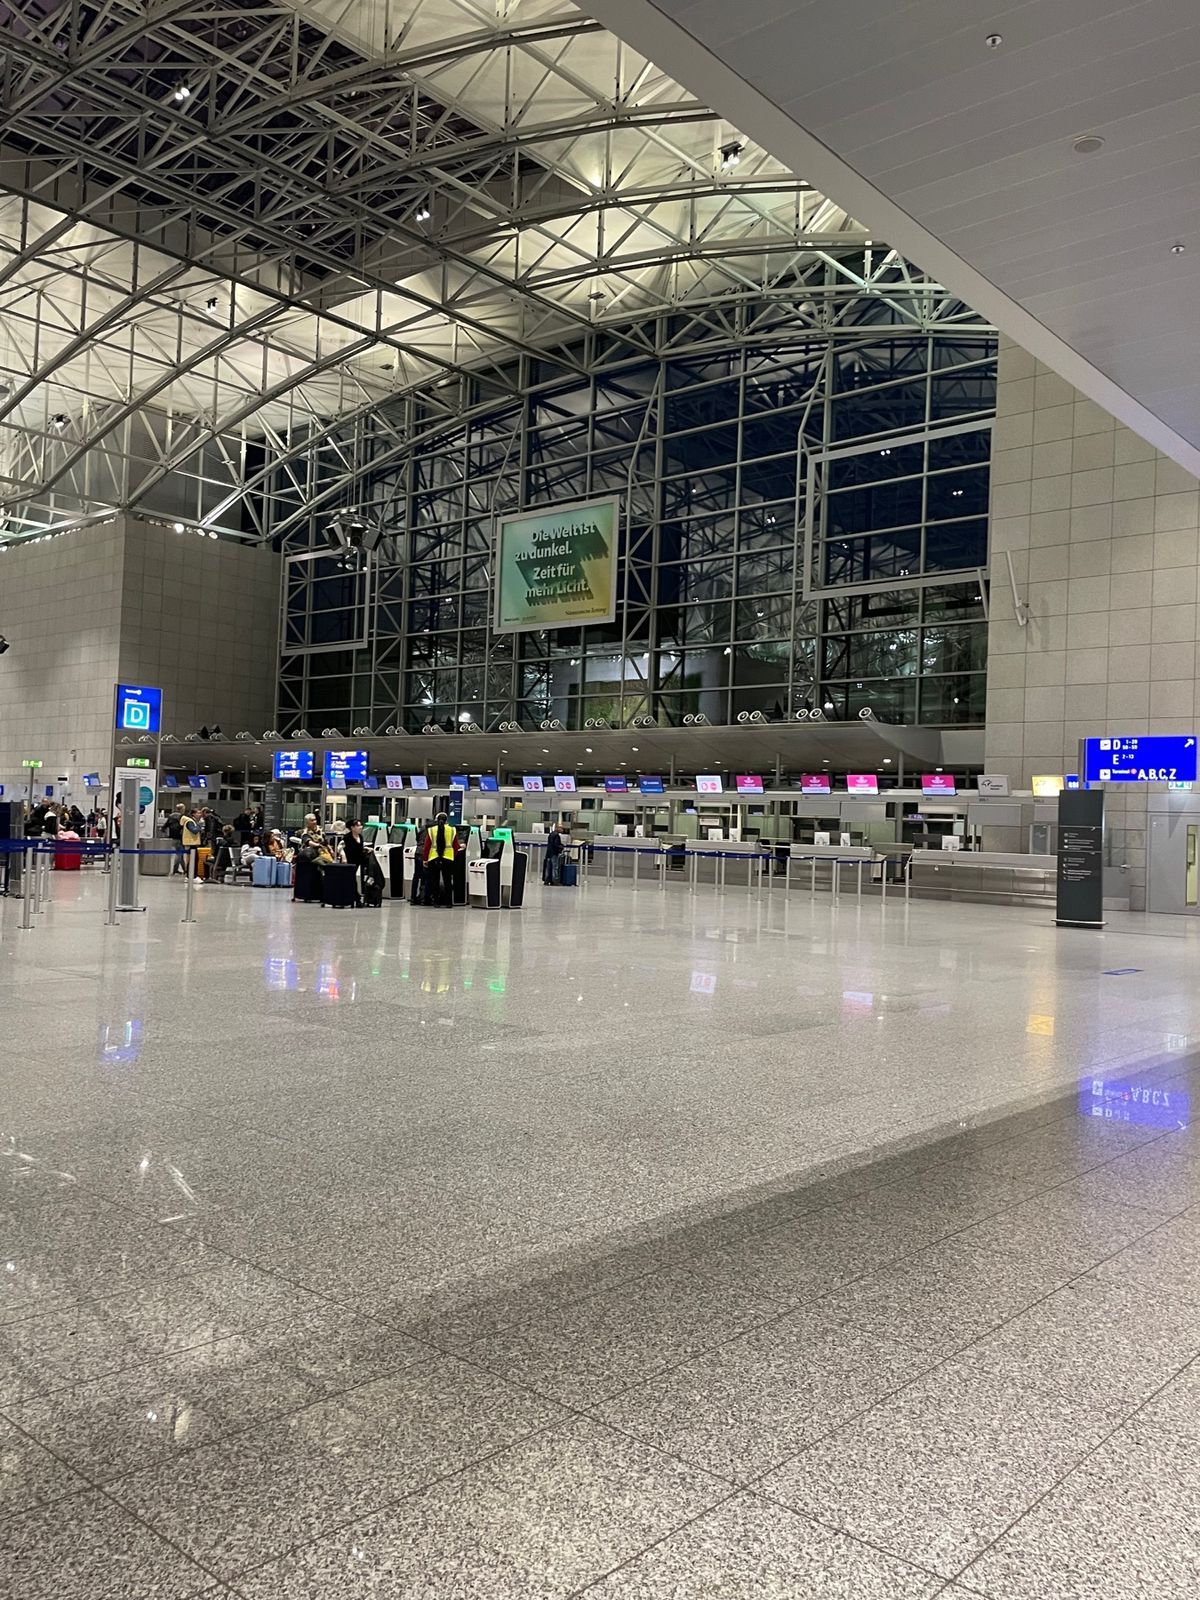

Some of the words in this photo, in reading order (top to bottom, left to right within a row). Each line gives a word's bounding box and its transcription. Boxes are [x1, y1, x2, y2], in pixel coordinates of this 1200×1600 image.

[532, 529, 549, 541] Die
[549, 524, 578, 540] Welt
[580, 522, 595, 535] ist
[515, 551, 528, 561] zu
[528, 541, 573, 559] dunkel.
[533, 566, 556, 580] Zeit
[557, 563, 576, 576] für
[526, 583, 554, 598] mehr
[557, 580, 589, 594] Licht.
[131, 707, 143, 723] D
[1113, 739, 1120, 750] D
[1113, 754, 1119, 765] E
[1138, 768, 1177, 780] A,B,C,Z
